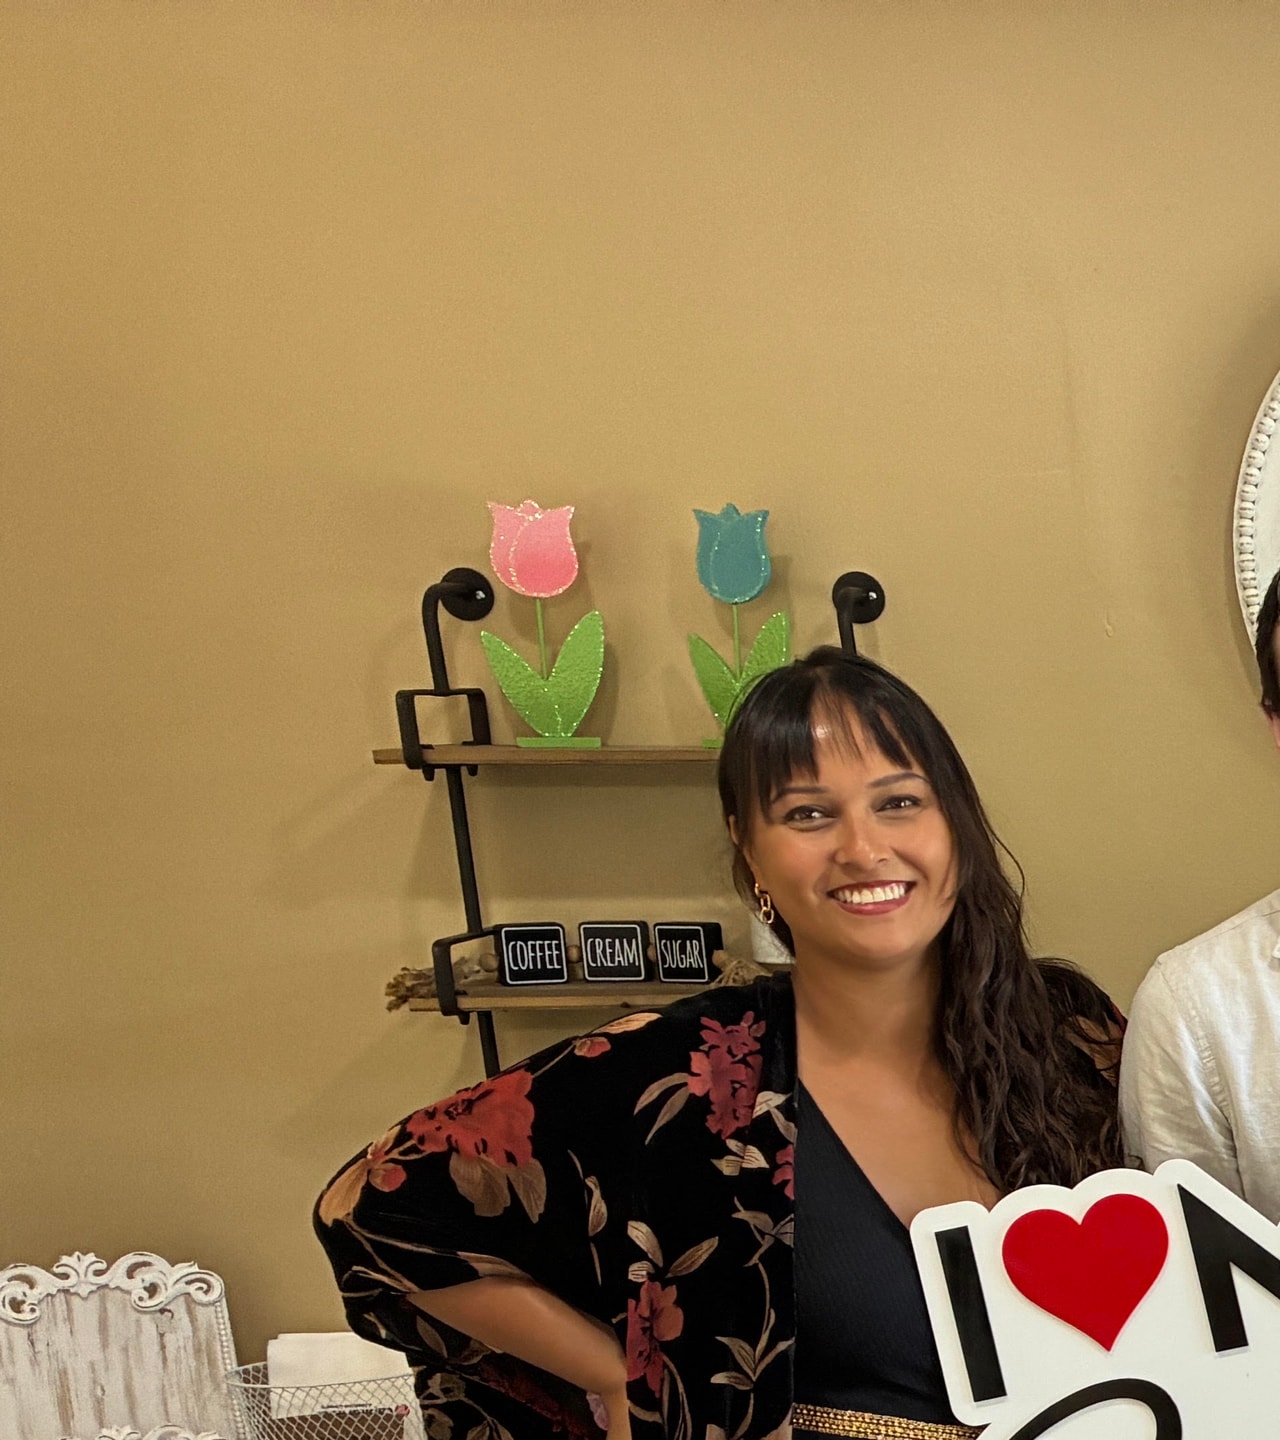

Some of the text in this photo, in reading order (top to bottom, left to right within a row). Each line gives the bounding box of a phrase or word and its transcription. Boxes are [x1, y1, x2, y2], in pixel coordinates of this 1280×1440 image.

[508, 940, 562, 971] COFFEE
[586, 938, 639, 968] CREAM
[660, 939, 704, 969] SUGAR
[935, 1226, 1007, 1403] I
